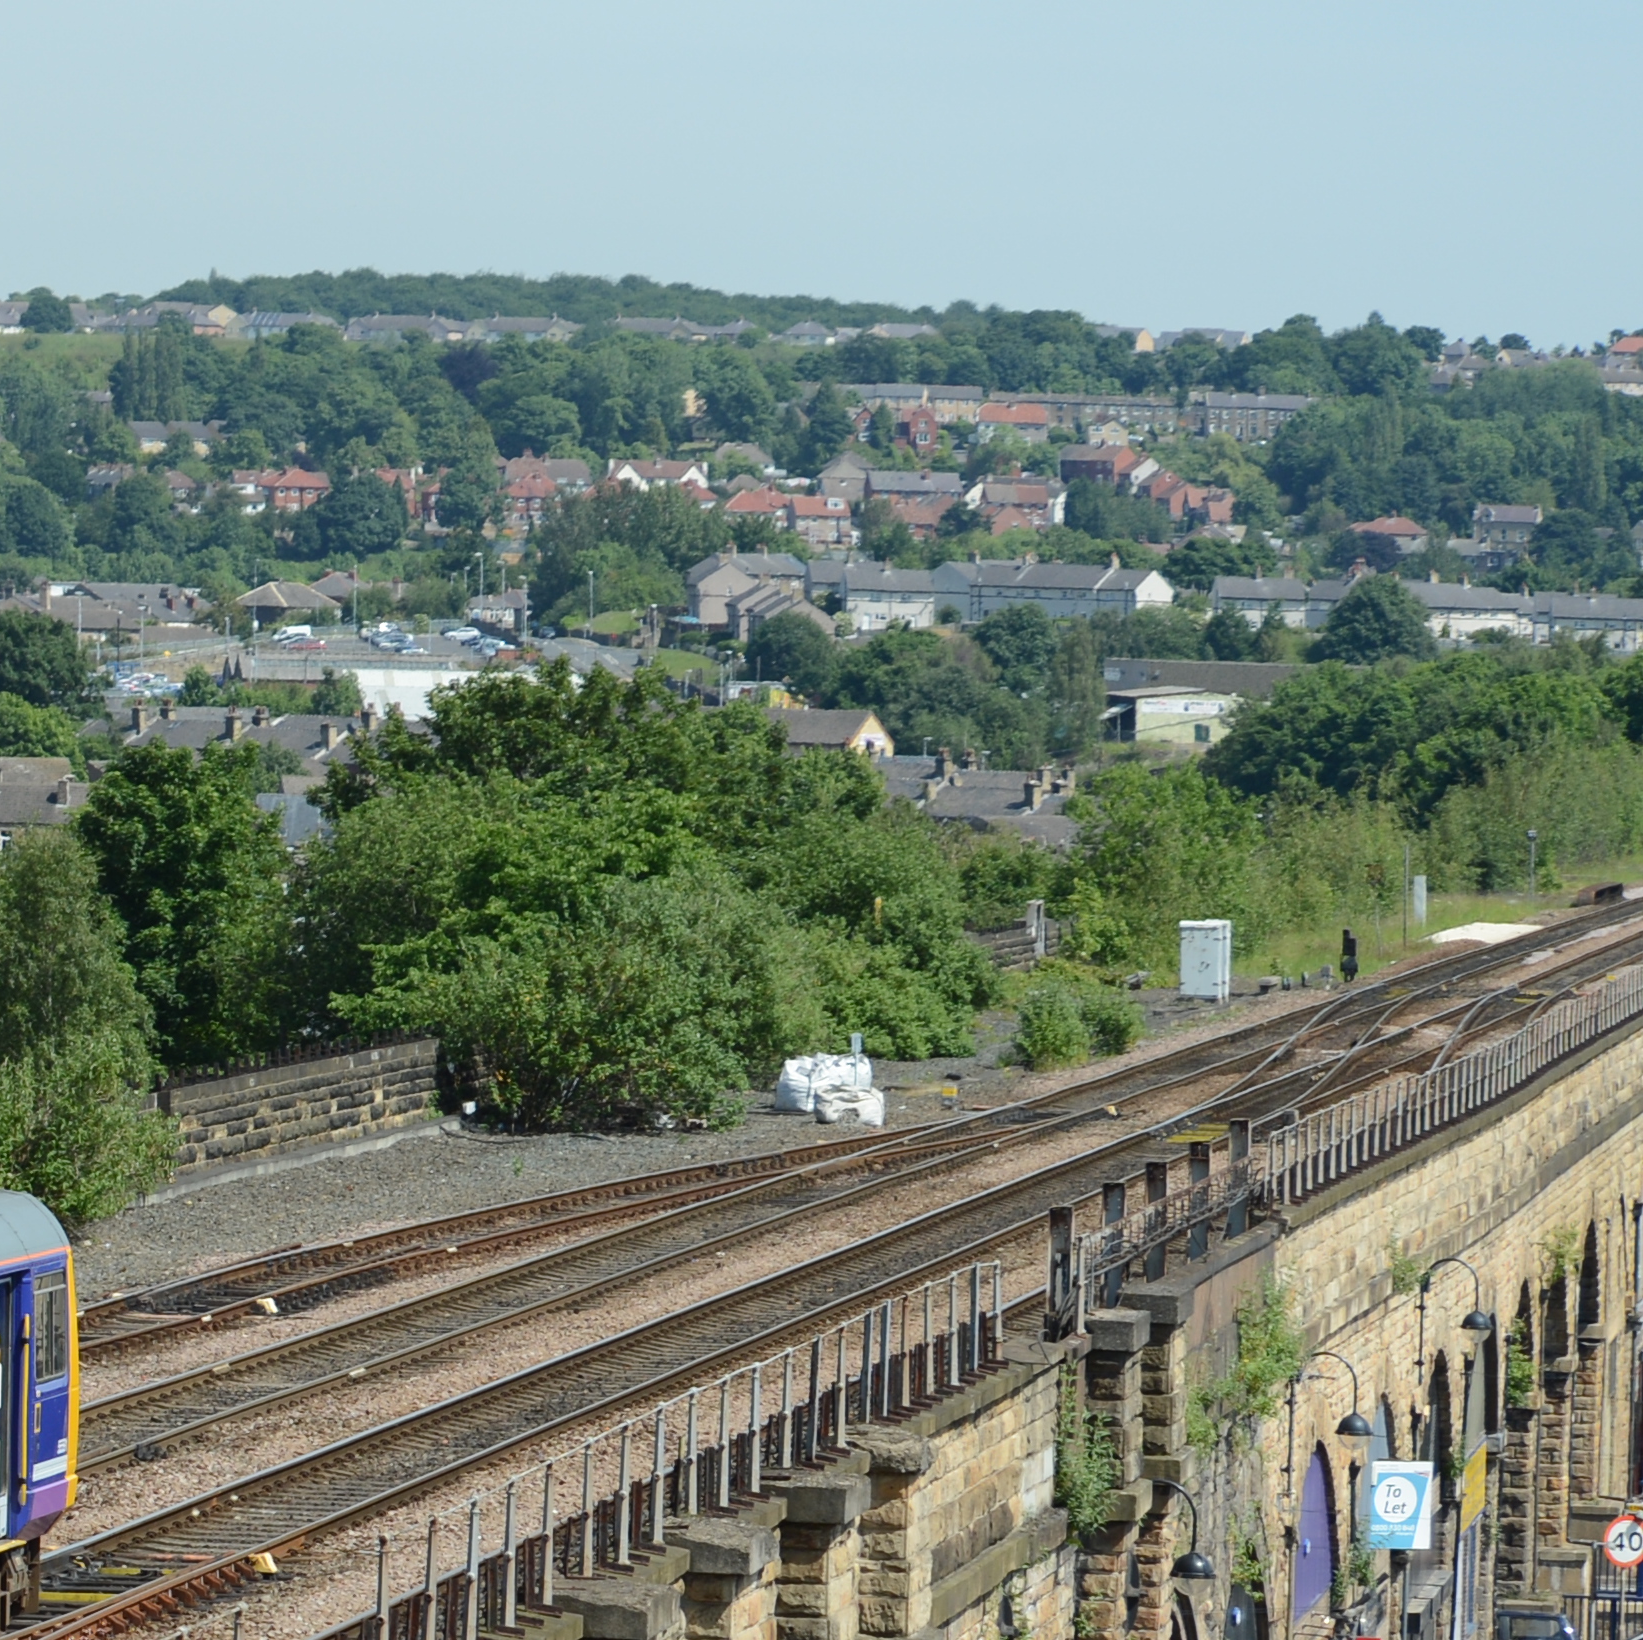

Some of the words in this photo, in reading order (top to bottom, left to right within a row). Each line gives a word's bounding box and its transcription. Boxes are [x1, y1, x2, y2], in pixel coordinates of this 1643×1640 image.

[1385, 1484, 1402, 1498] To
[1383, 1500, 1407, 1514] Let
[1613, 1531, 1642, 1552] 40
